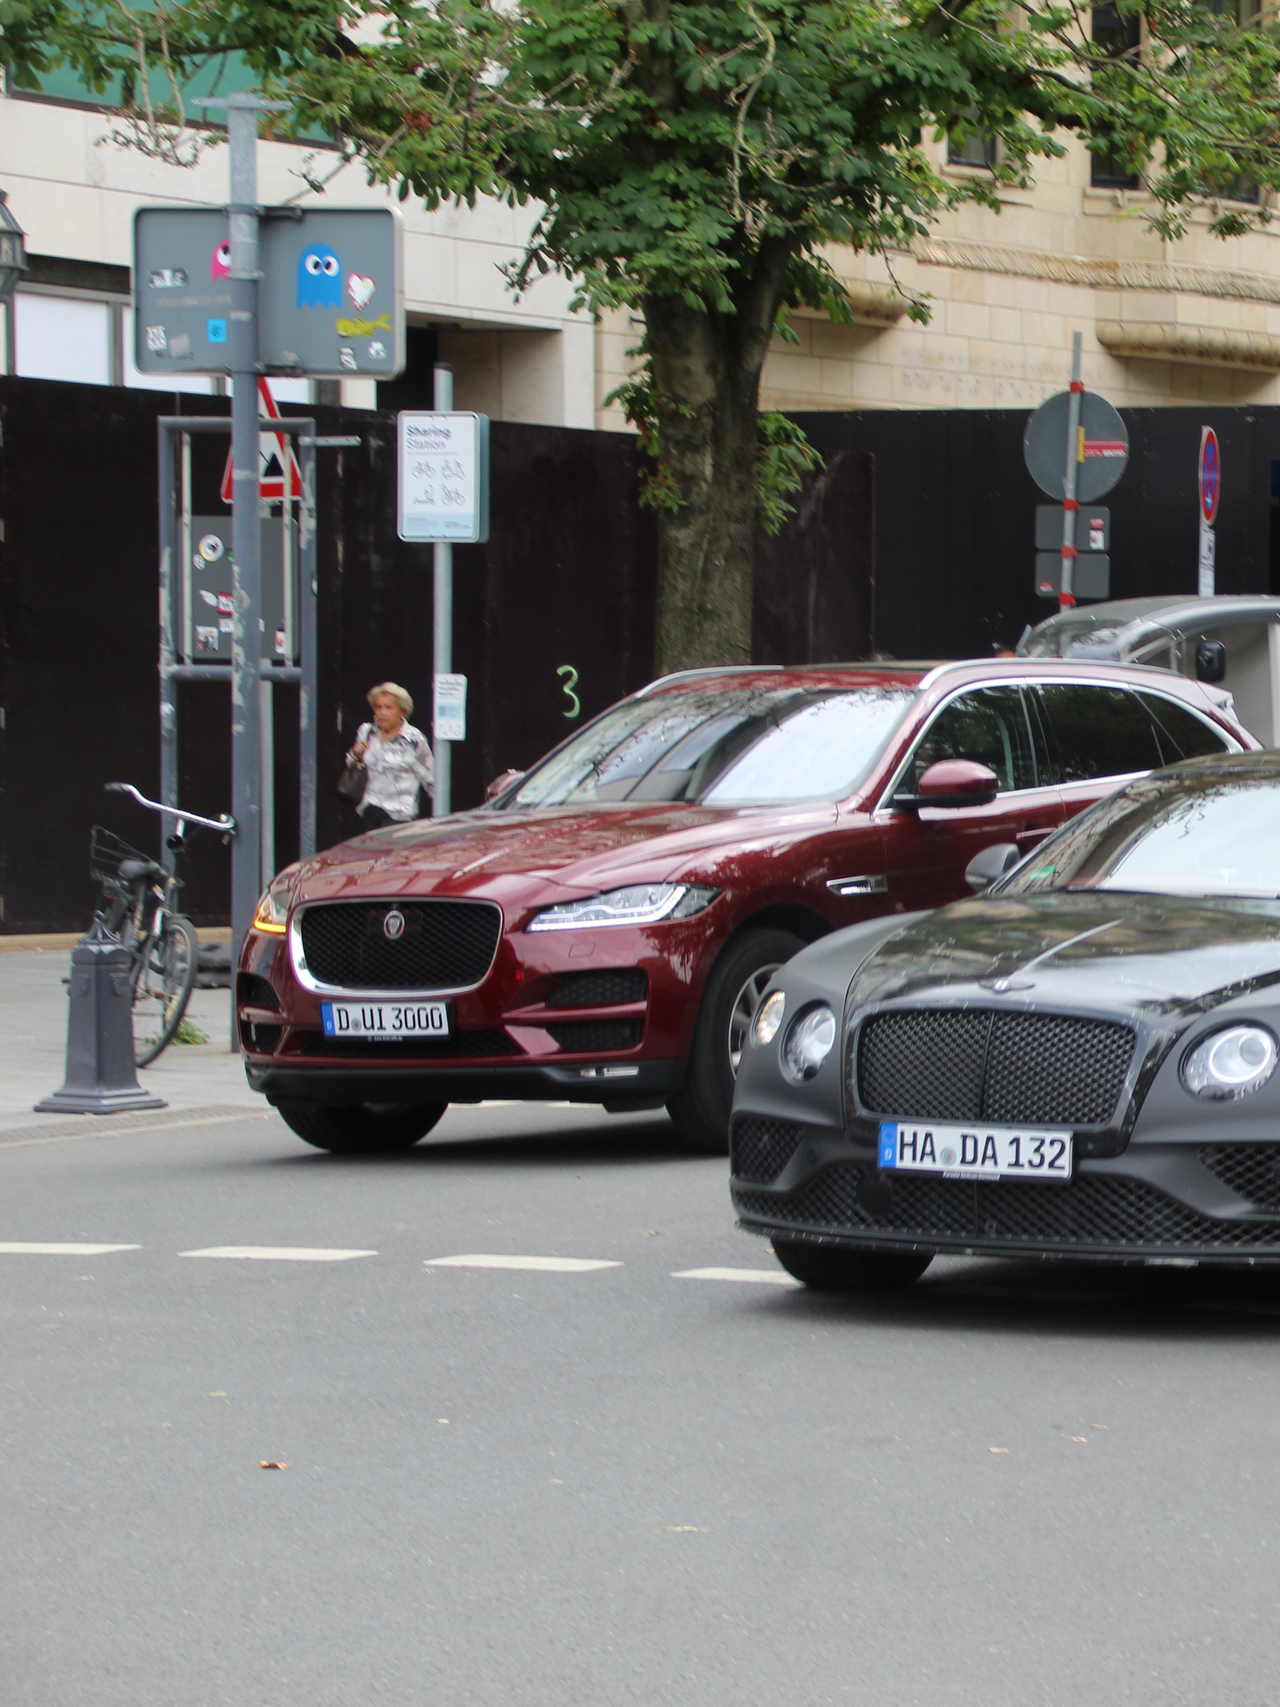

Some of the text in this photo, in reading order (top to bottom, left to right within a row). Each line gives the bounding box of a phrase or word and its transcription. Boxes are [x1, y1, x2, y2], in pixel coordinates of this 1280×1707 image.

[406, 425, 451, 440] Sharing
[406, 438, 446, 450] Station
[556, 664, 581, 719] 3
[337, 1007, 350, 1031] D
[362, 1007, 386, 1031] UI
[391, 1007, 443, 1030] 3000
[900, 1130, 936, 1163] HA
[960, 1133, 998, 1167] DA
[1007, 1136, 1067, 1170] 132
